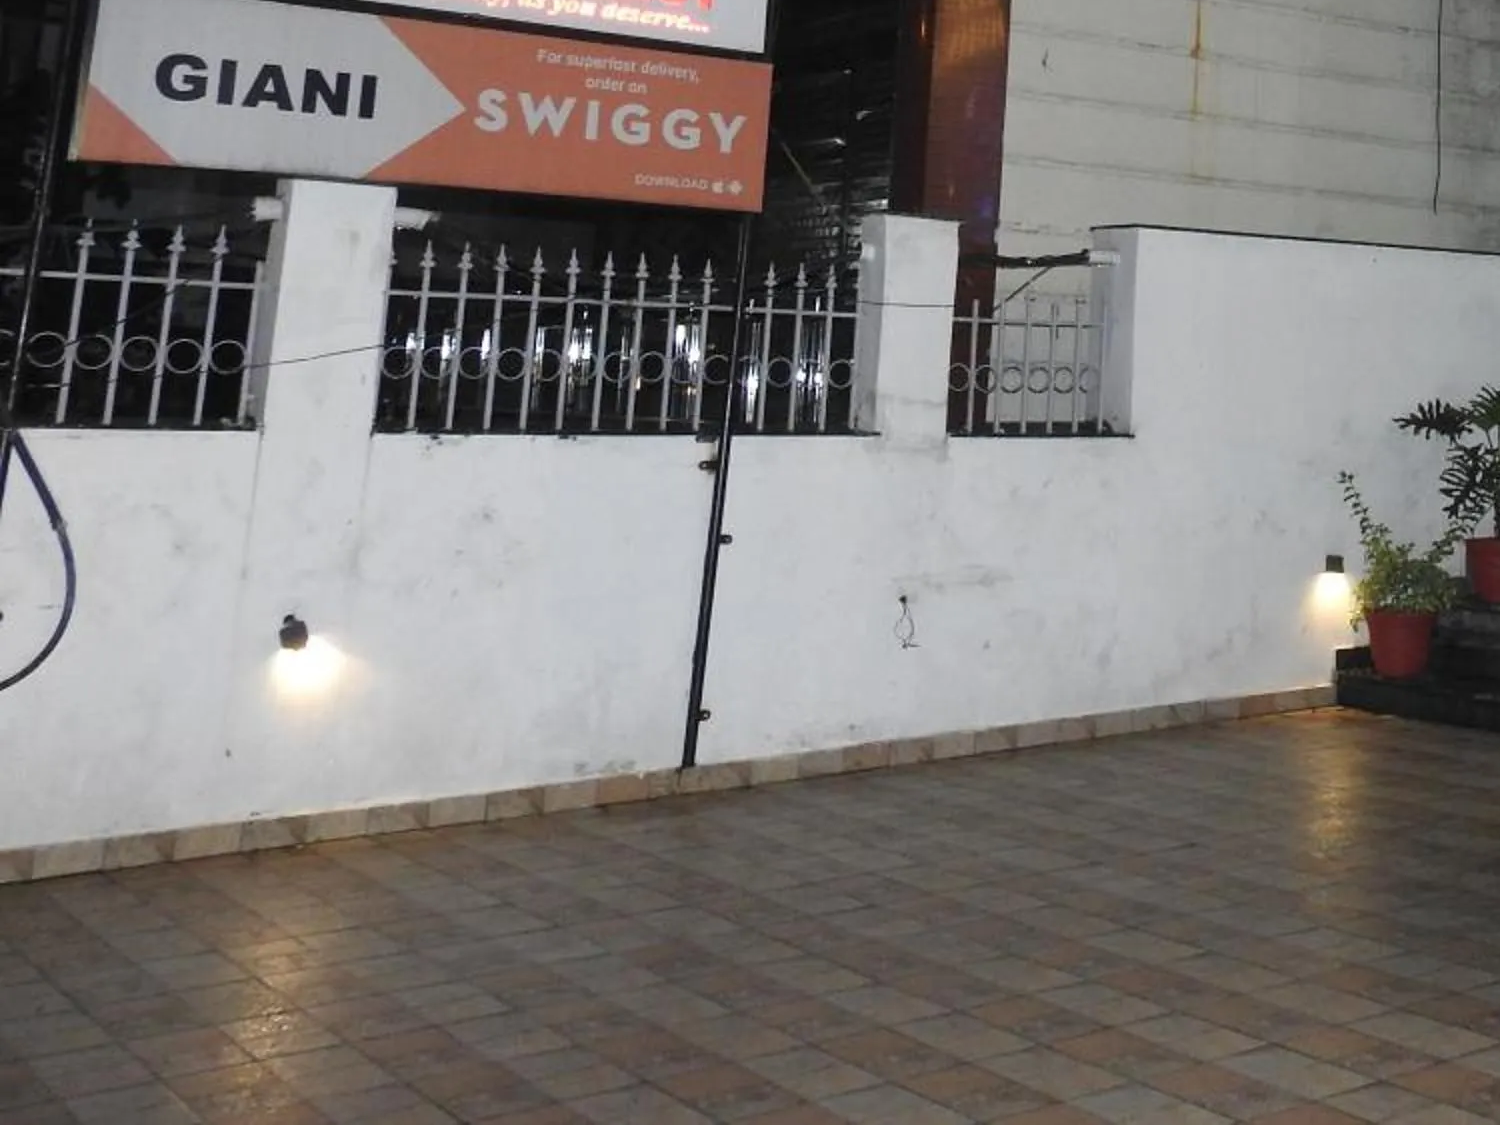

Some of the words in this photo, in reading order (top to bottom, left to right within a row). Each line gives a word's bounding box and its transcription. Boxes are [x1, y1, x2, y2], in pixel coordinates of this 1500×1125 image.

[601, 1, 711, 33] deserve...
[536, 49, 563, 64] For
[566, 53, 637, 75] superfast
[641, 60, 700, 85] delivery,
[155, 53, 378, 120] GIANI
[585, 76, 626, 92] order
[629, 81, 648, 95] on
[473, 88, 748, 155] SWIGGY
[634, 174, 709, 191] DOWNLOAD
